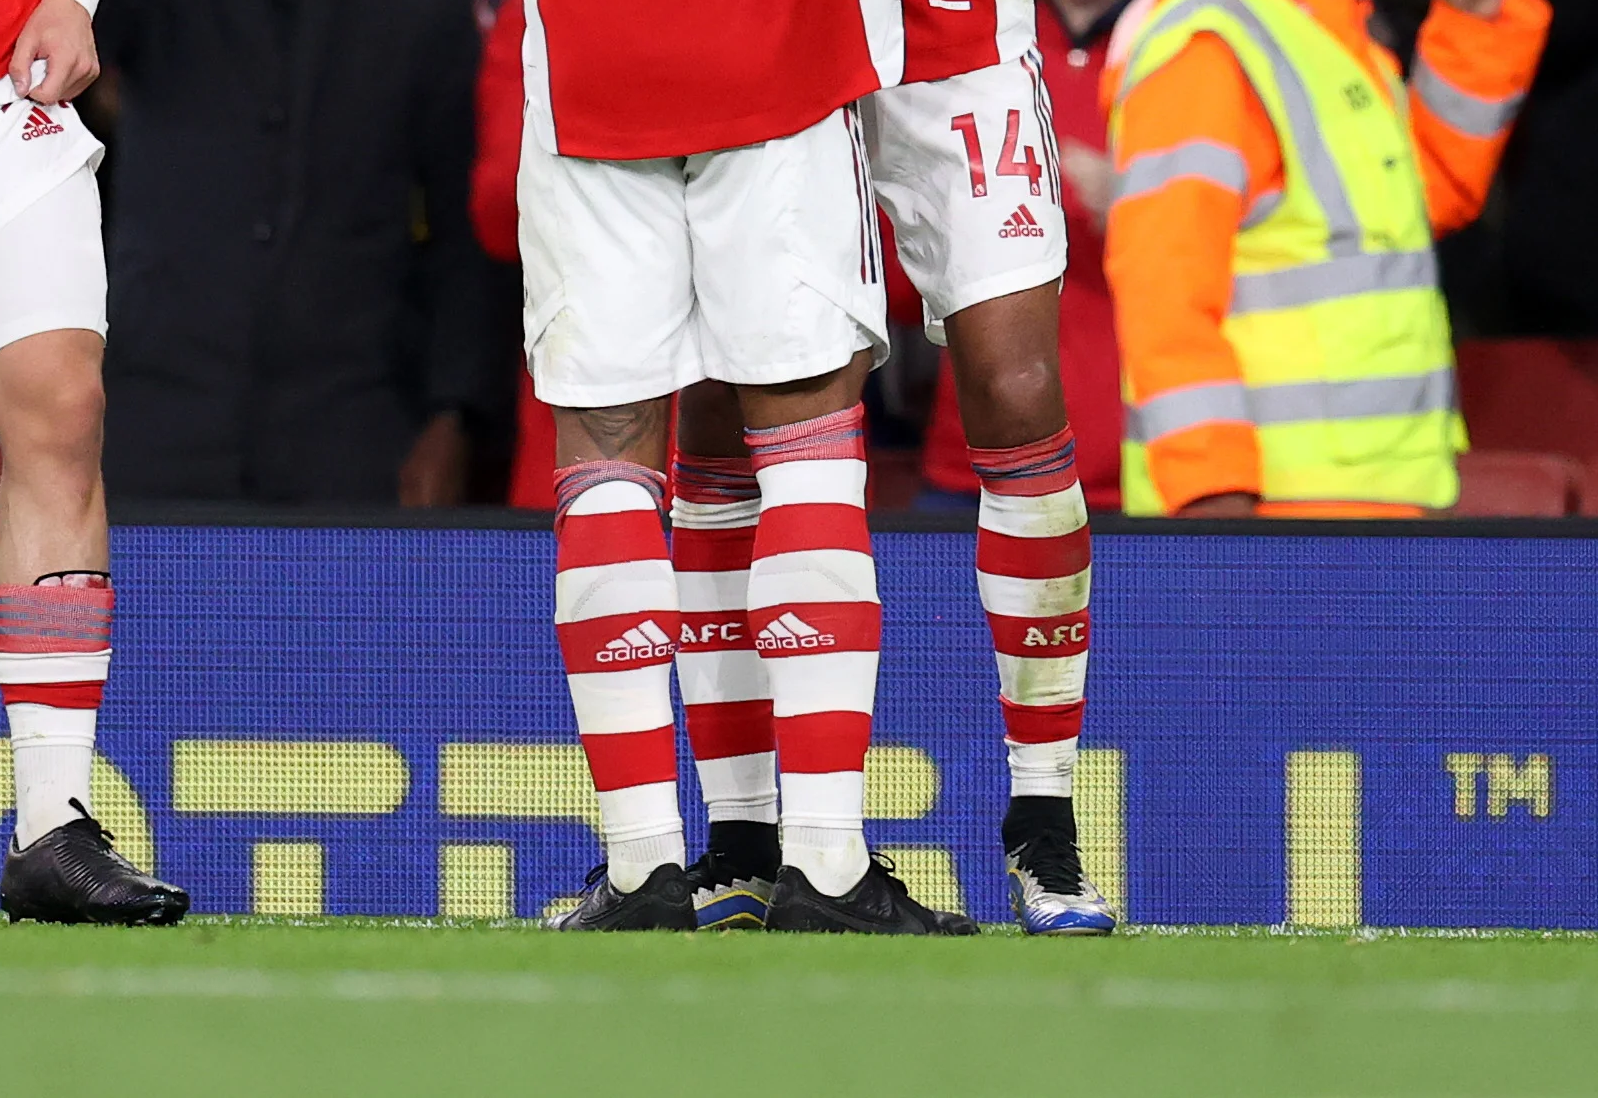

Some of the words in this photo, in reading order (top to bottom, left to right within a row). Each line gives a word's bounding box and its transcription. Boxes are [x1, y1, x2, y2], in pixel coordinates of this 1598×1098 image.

[22, 124, 64, 141] adidas
[951, 109, 1042, 198] 14
[998, 223, 1045, 239] adidas
[680, 622, 742, 644] AFC
[755, 630, 834, 650] adidas
[1023, 622, 1087, 646] AFC
[596, 640, 677, 662] adidas
